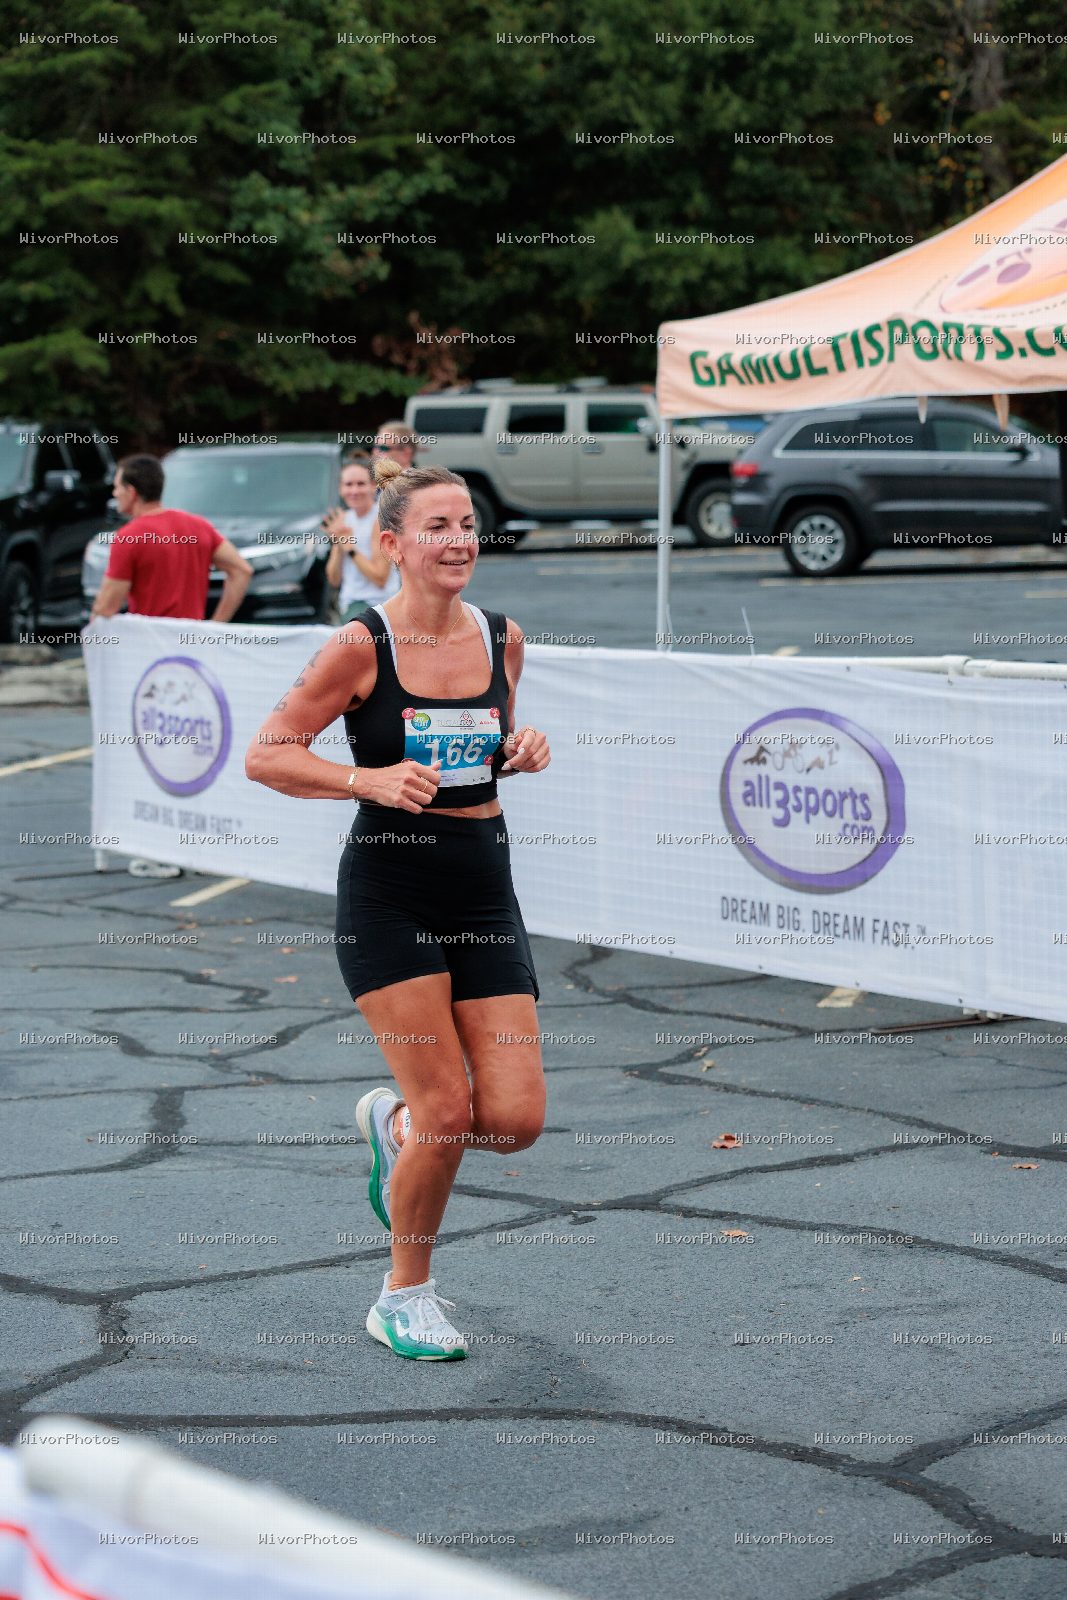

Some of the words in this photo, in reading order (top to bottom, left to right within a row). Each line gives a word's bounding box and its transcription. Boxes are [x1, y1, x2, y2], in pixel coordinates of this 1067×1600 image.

[424, 738, 484, 767] 166
[742, 774, 872, 828] all3sports
[721, 896, 770, 928] DREAM
[776, 904, 805, 933] BIG.
[812, 909, 865, 943] DREAM
